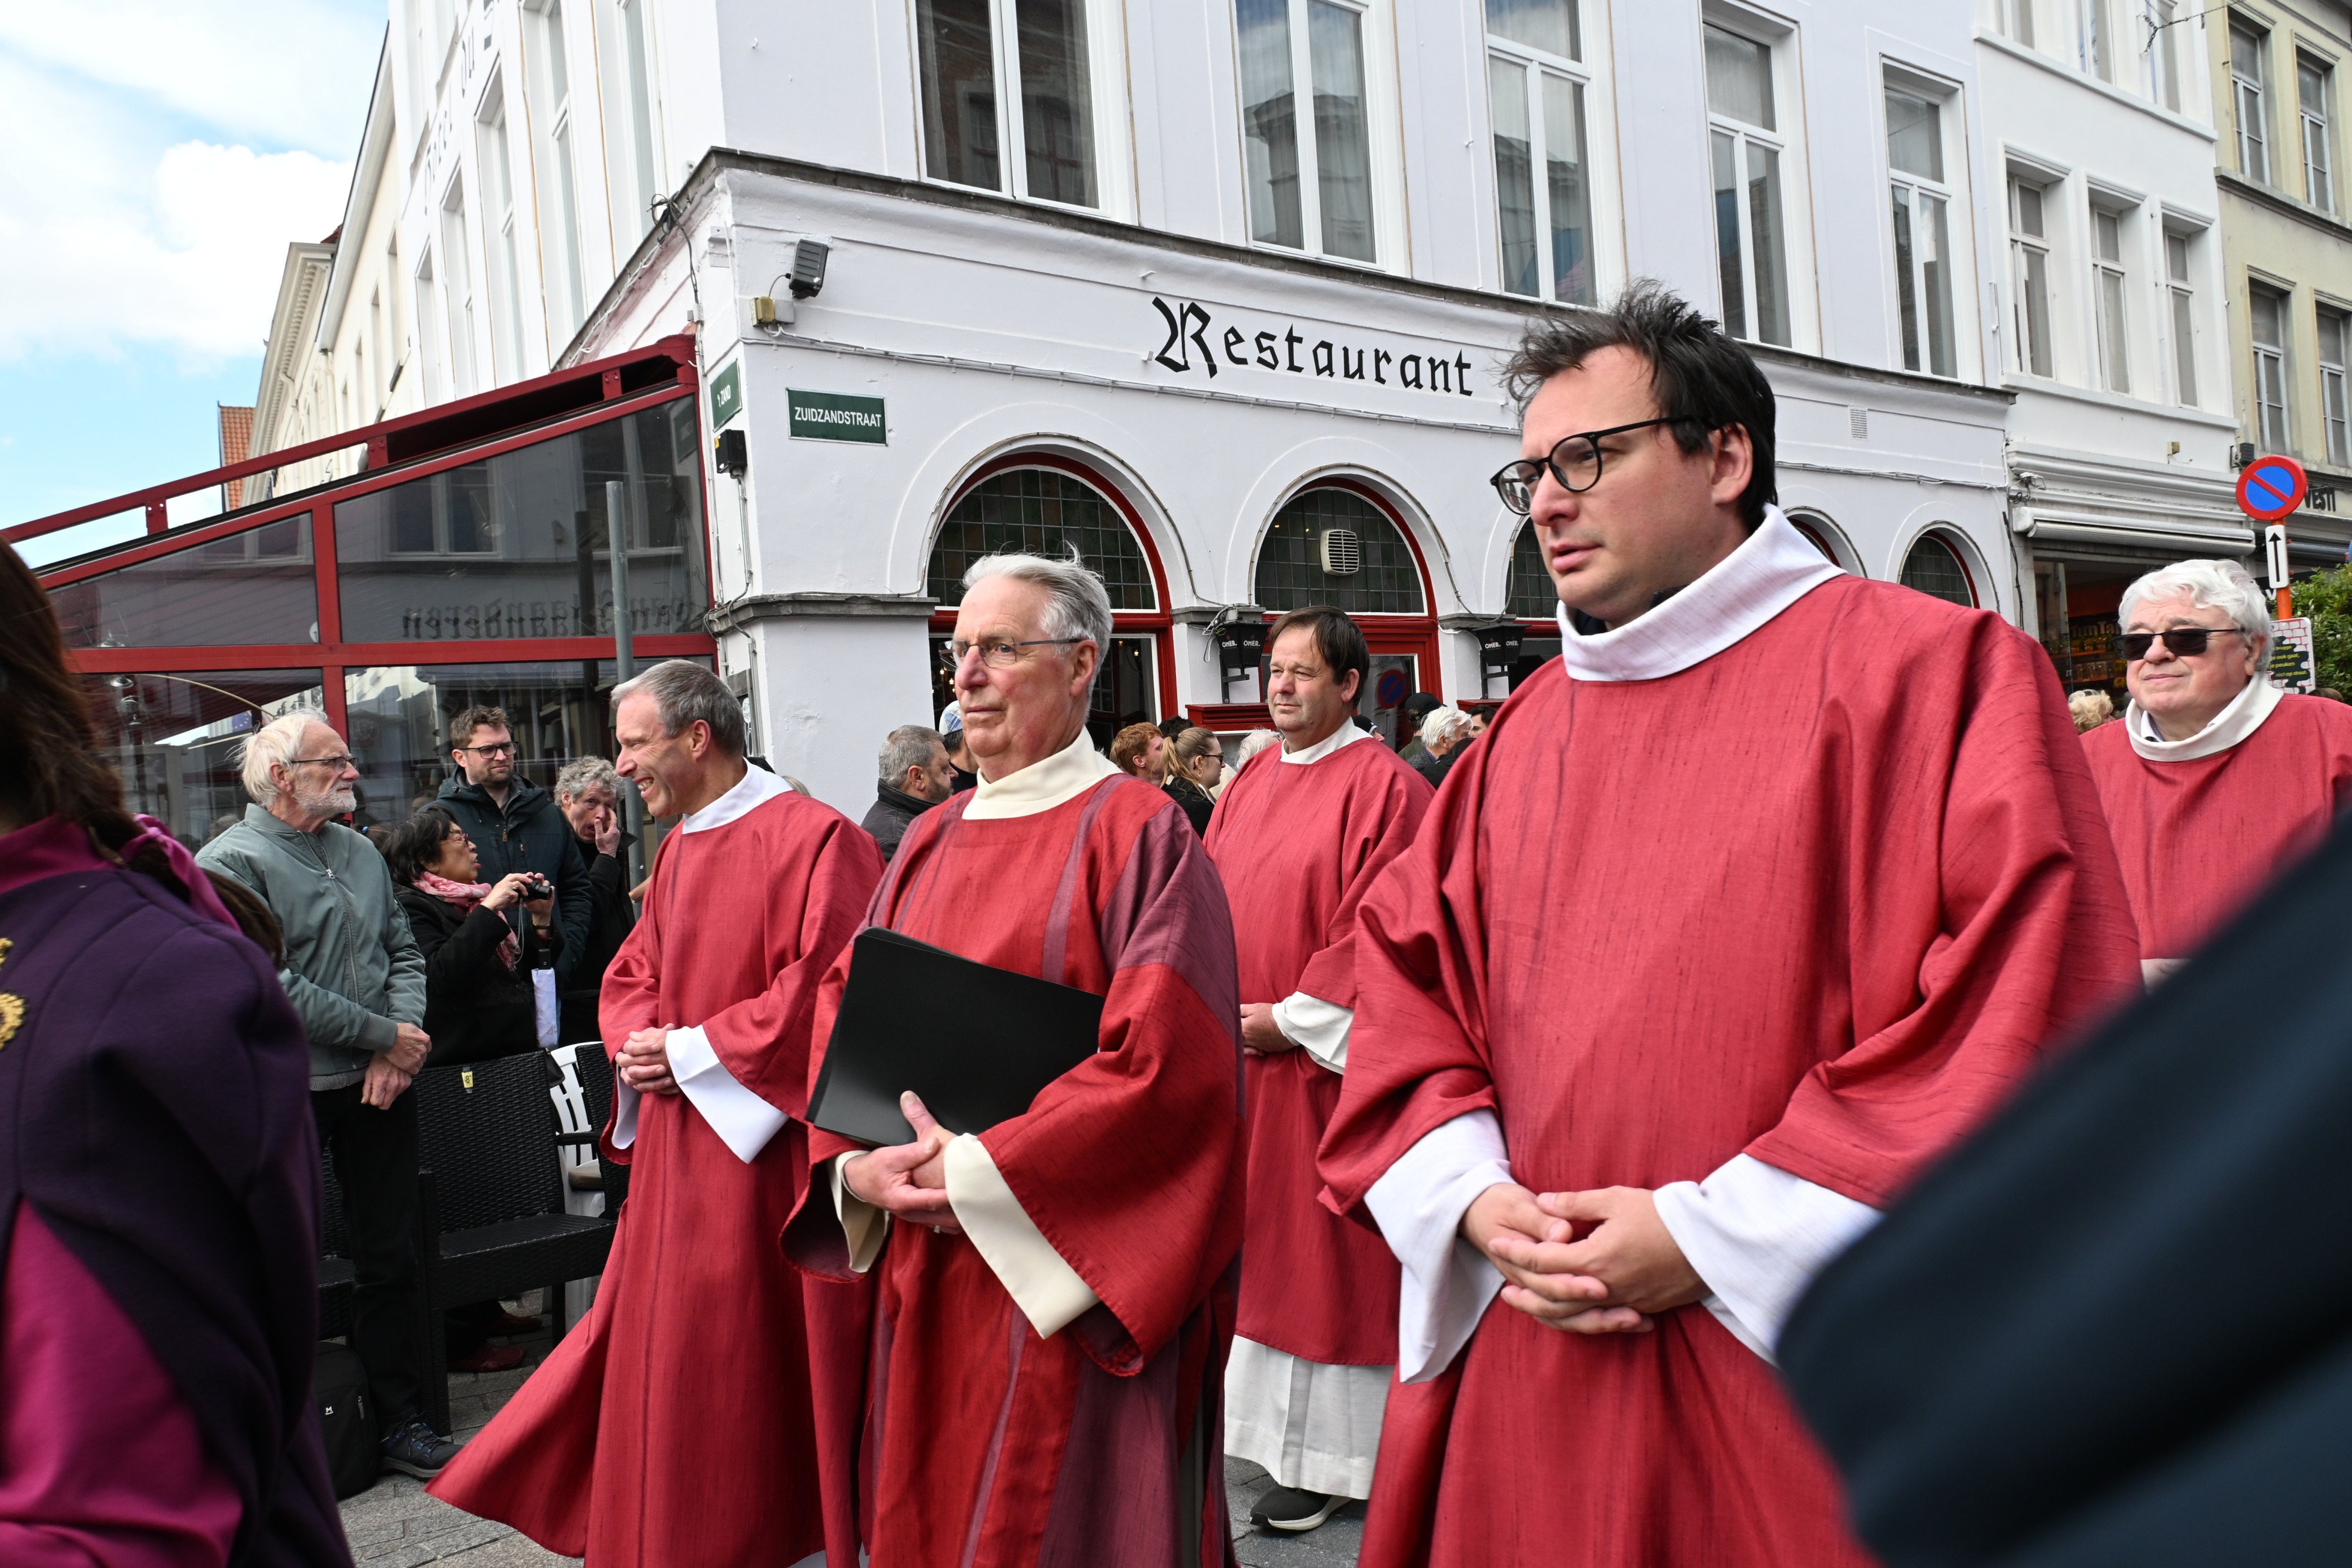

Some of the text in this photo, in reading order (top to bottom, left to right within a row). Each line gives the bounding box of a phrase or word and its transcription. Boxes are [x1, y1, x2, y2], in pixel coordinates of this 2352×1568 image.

[1151, 296, 1474, 397] Restaurant
[720, 384, 731, 406] ZAND
[794, 406, 881, 427] ZUIDZANDSTRAAT
